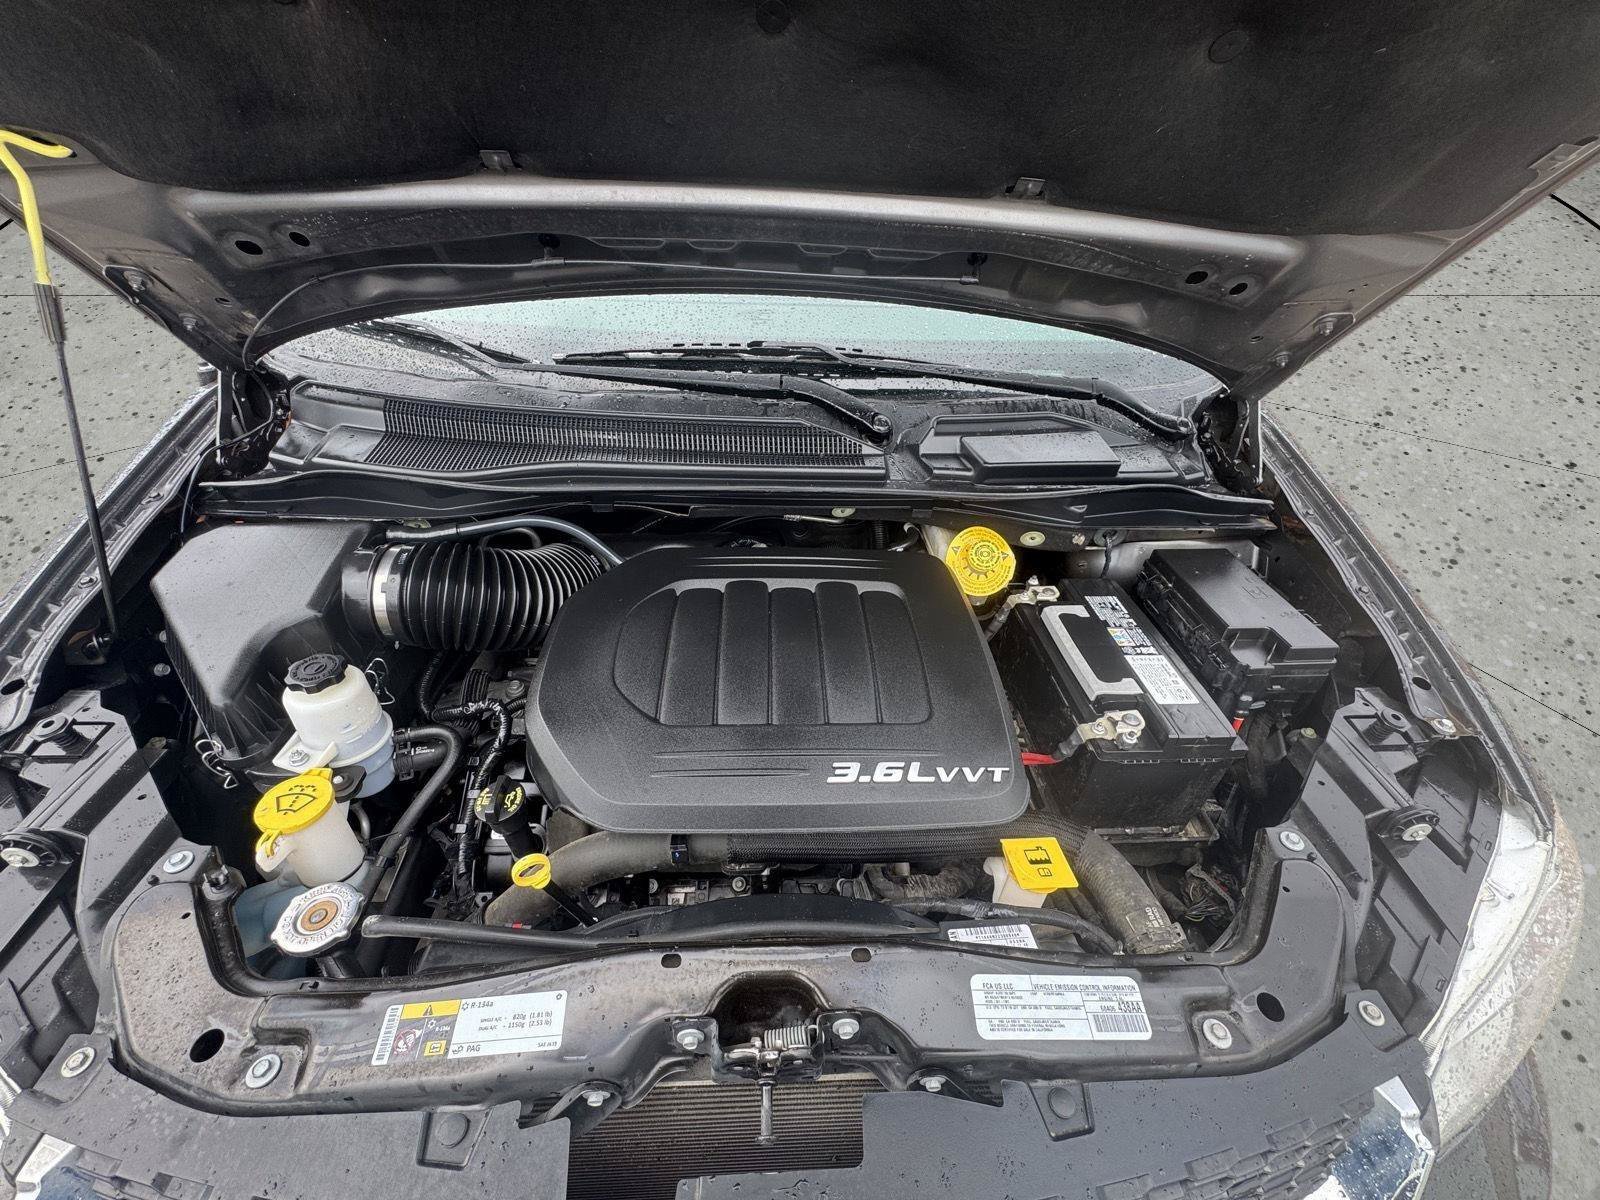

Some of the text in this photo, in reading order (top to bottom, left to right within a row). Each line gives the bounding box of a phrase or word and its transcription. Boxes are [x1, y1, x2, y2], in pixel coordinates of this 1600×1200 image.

[982, 982, 1014, 990] FCA US LLC
[1033, 983, 1054, 991] VEHICLE
[1054, 983, 1079, 991] EMISSION
[1101, 984, 1136, 992] INFORMATION
[470, 1000, 494, 1009] R-134a
[512, 1013, 526, 1021] 820g
[466, 1044, 481, 1053] PAG
